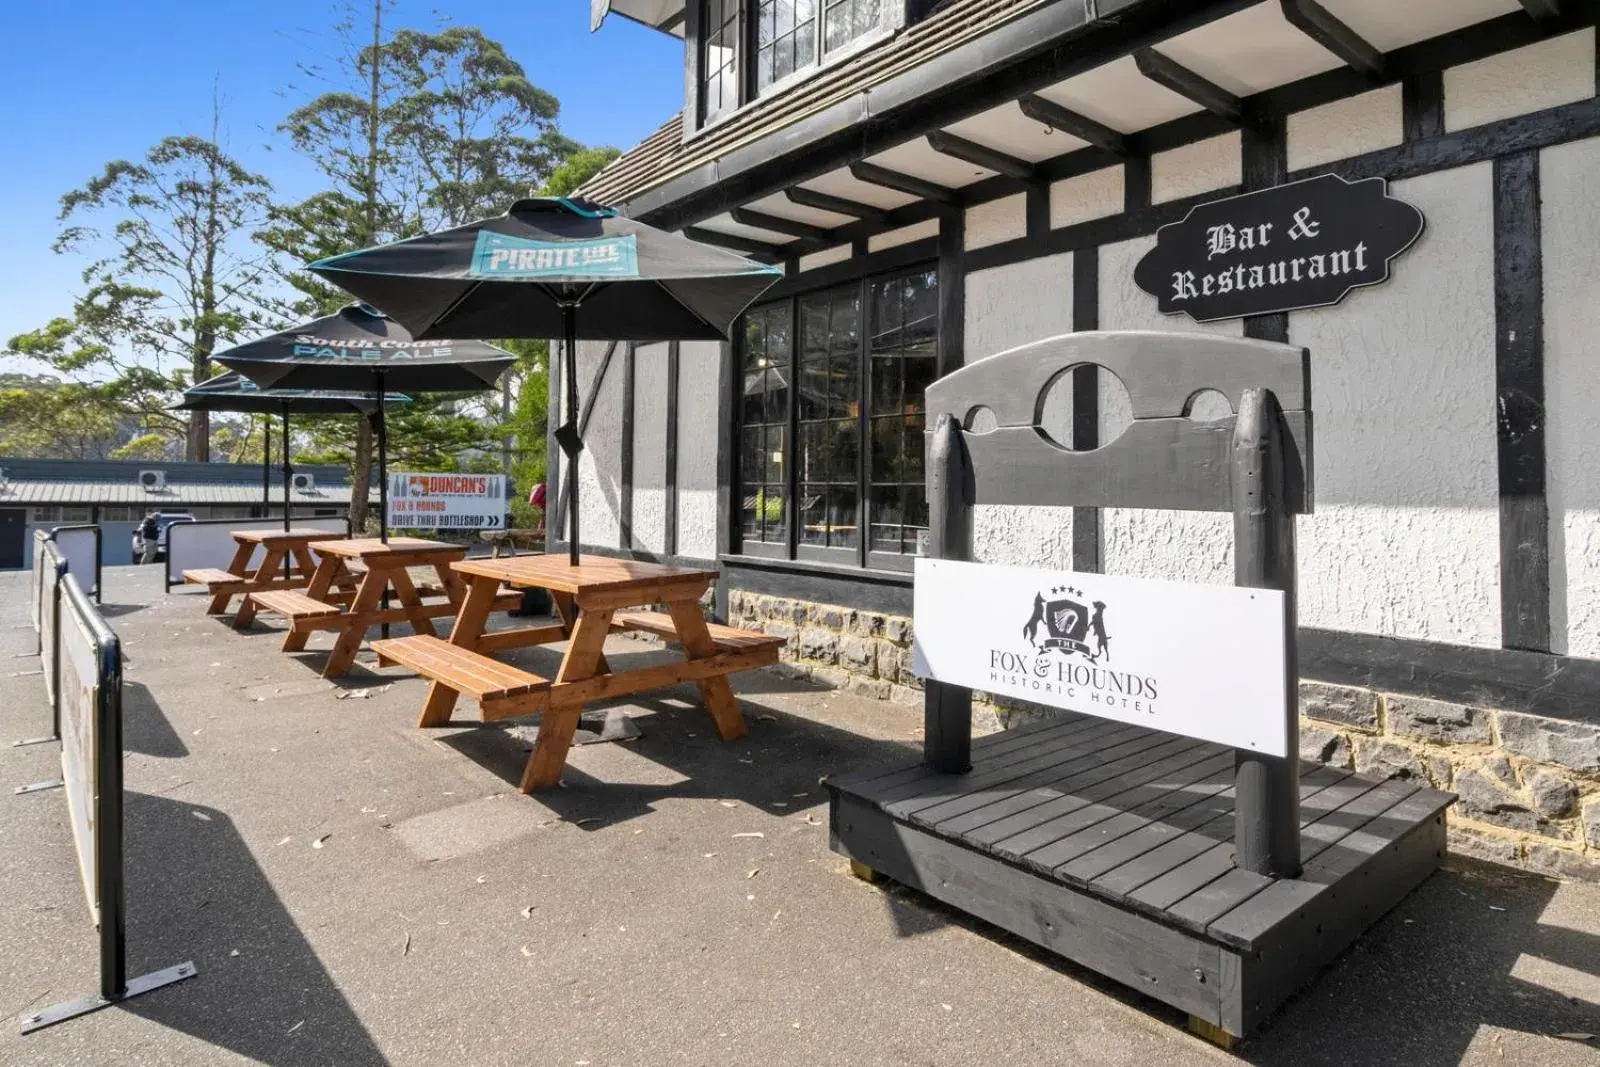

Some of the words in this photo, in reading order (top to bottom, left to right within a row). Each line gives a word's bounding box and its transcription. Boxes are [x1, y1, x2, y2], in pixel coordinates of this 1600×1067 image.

[1206, 222, 1273, 261] Bar
[1287, 206, 1321, 241] &
[1171, 241, 1368, 302] Restaurant
[293, 345, 381, 360] PALE
[390, 346, 453, 360] ALE
[431, 476, 486, 493] DUNCAN'S
[392, 501, 406, 511] FOX
[416, 501, 446, 511] HOUNDS
[392, 515, 413, 526] DRIVE
[417, 515, 437, 526] THRU
[440, 515, 484, 526] BOTTLESHOP
[1057, 639, 1077, 650] THE
[990, 649, 1028, 675] FOX
[1033, 656, 1051, 678] &
[1058, 661, 1158, 700] HOUNDS
[990, 673, 1075, 698] HISTORIC
[1092, 691, 1156, 714] HOTEL
